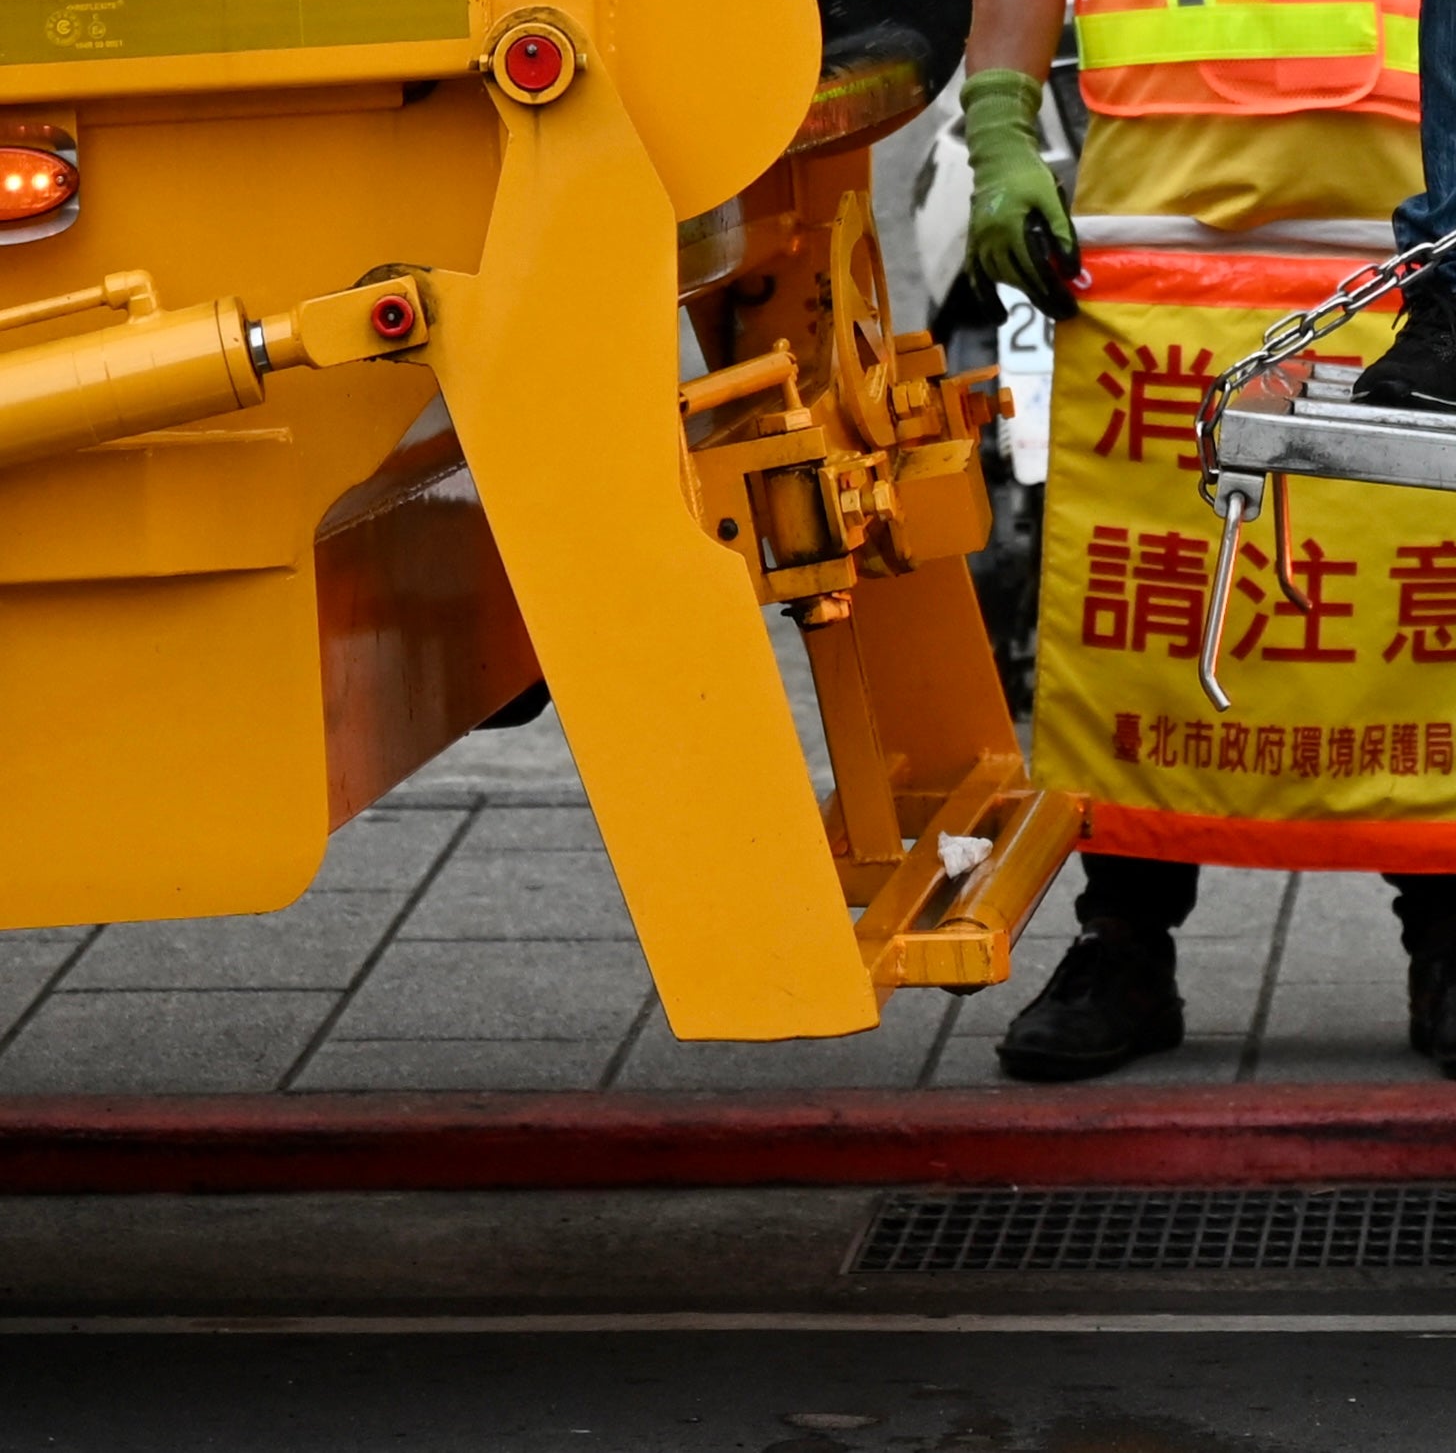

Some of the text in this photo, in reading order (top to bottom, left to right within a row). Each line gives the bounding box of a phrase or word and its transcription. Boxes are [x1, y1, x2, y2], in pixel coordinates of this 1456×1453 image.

[1113, 713, 1455, 779] 臺北市政府環境保護局
